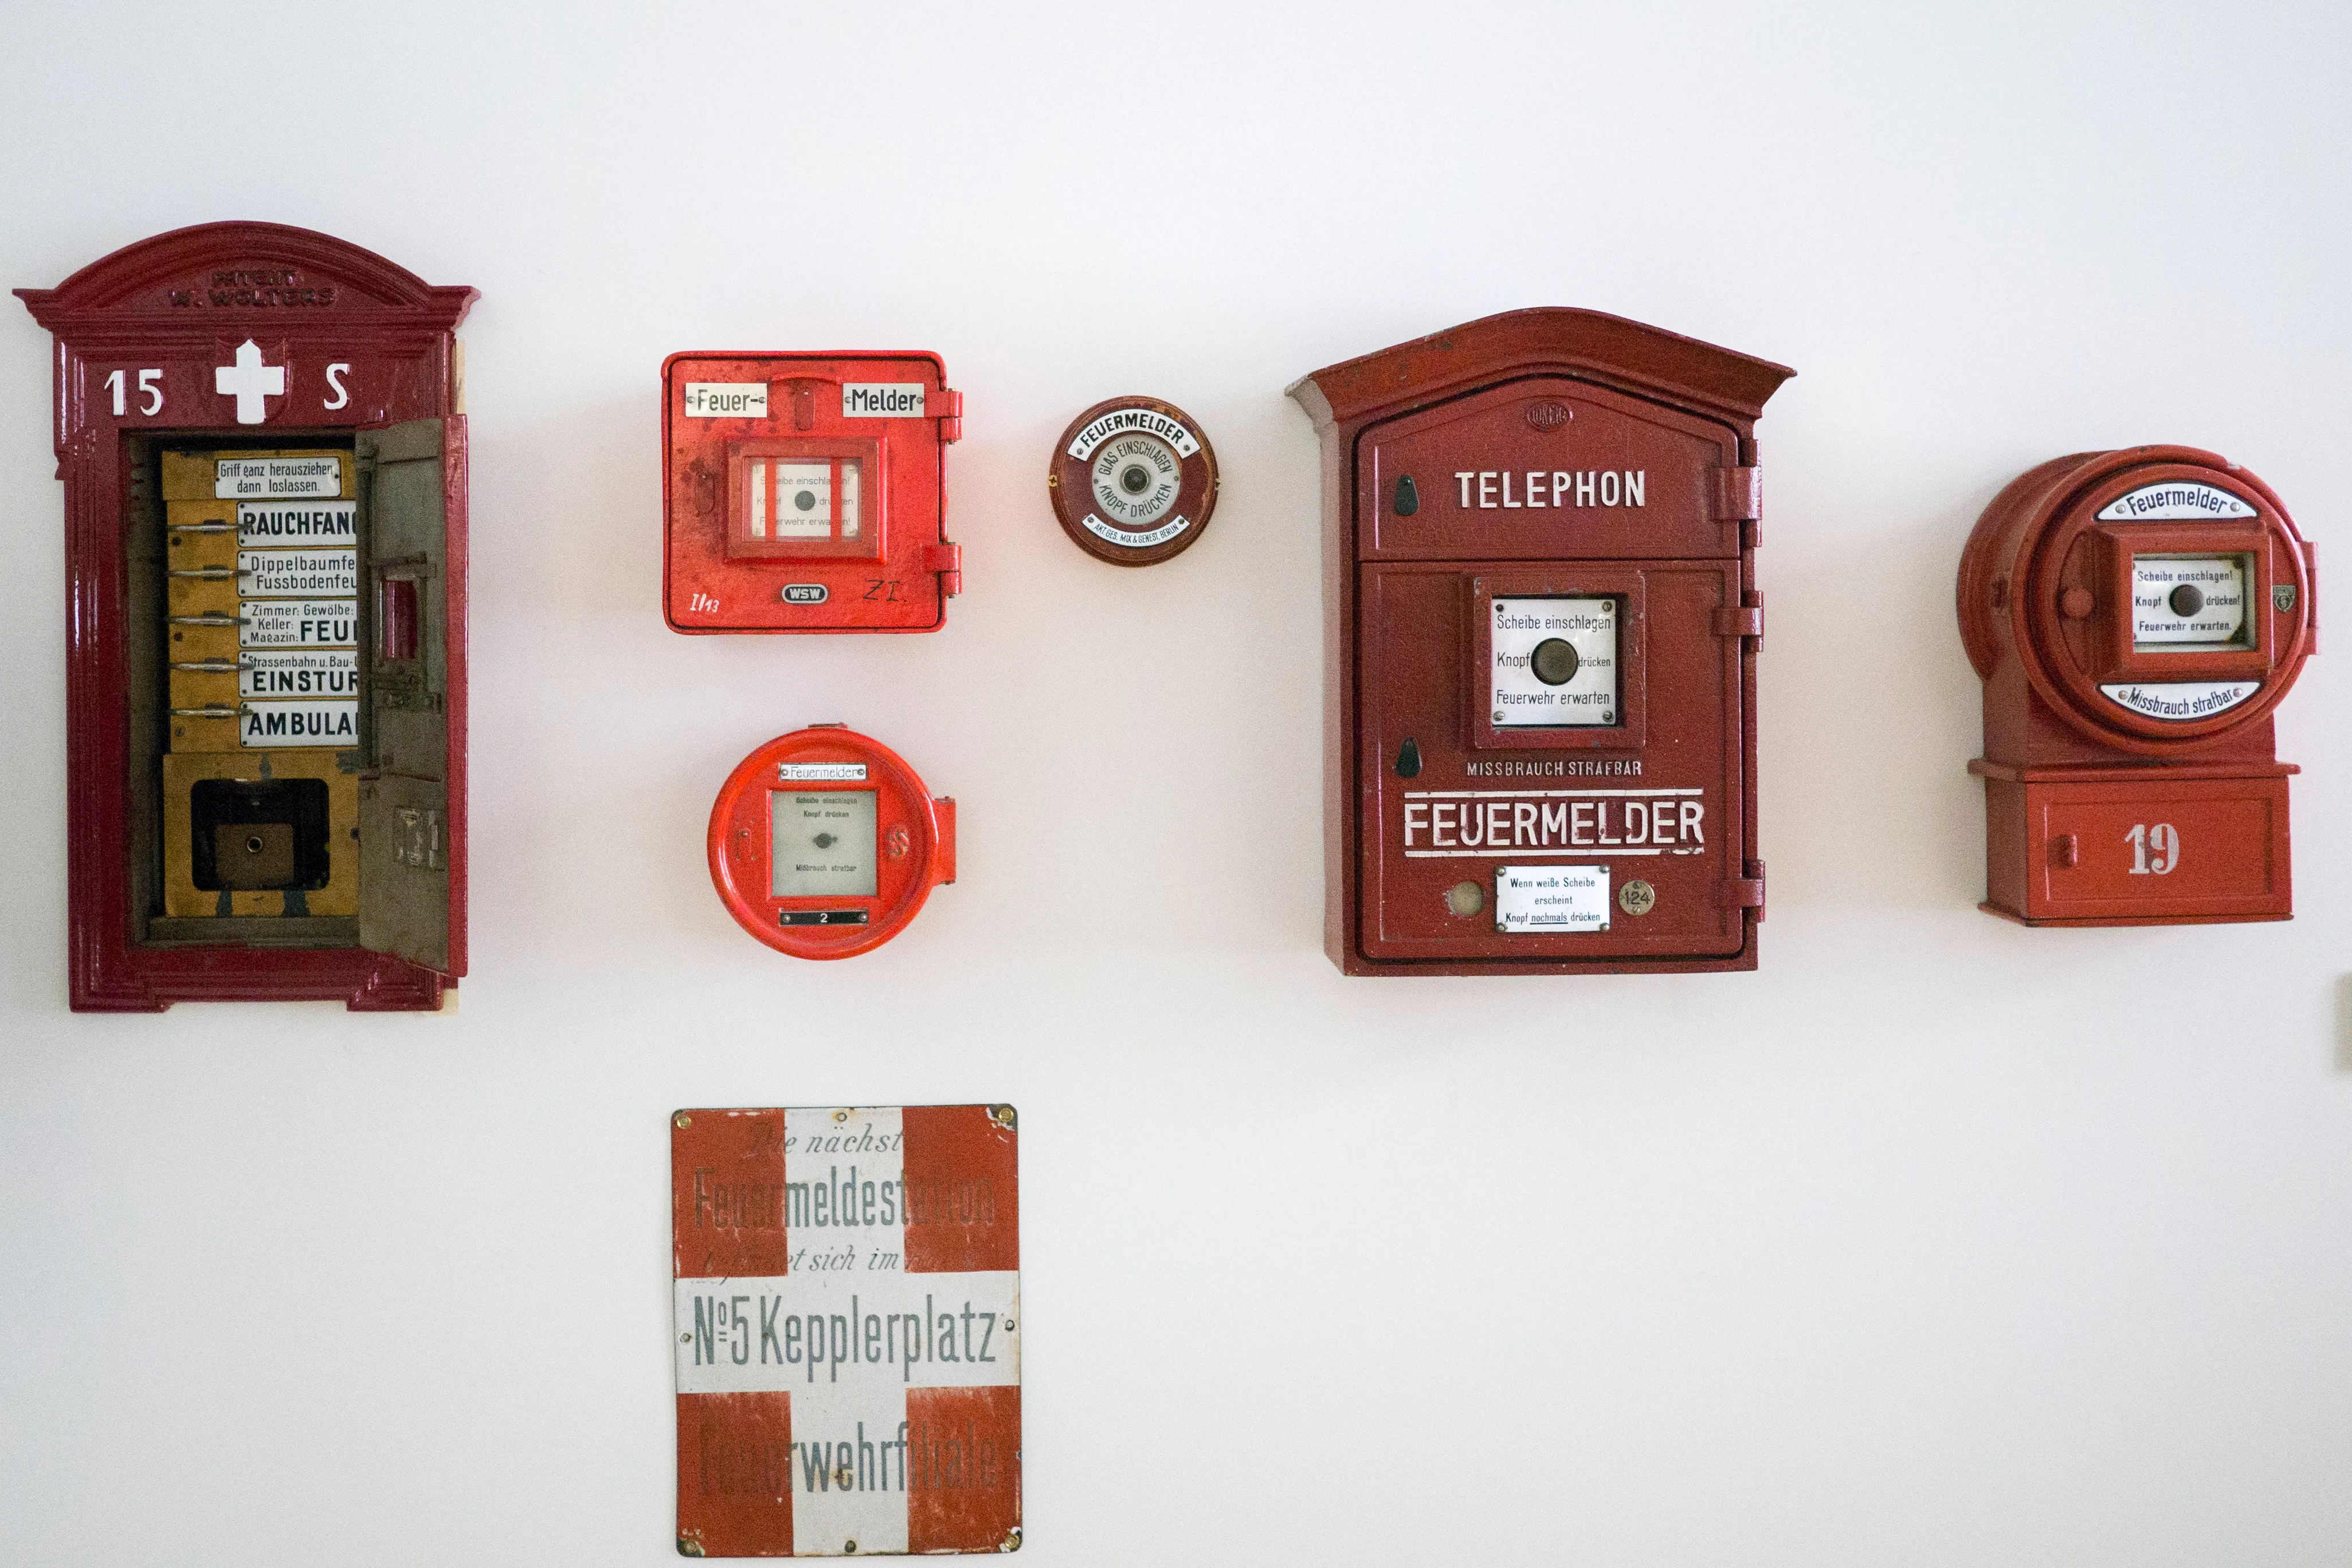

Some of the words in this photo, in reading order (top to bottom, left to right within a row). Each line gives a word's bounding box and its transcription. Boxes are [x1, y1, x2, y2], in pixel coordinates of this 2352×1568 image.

[104, 369, 163, 416] 15
[324, 363, 350, 410] S
[851, 389, 916, 411] Melder
[1080, 413, 1184, 448] FEUERMELDER
[1098, 450, 1119, 476] GLAS
[1116, 440, 1173, 474] EINSCHLAGEN
[221, 463, 241, 477] Griff
[243, 465, 265, 479] ganz
[269, 461, 333, 476] herausziehen
[237, 479, 261, 493] dann
[269, 479, 320, 492] loslassen.
[760, 476, 794, 485] Seibe
[796, 476, 850, 486] einschlan!
[1455, 470, 1645, 508] TELEPHON
[1099, 484, 1128, 515] KNOPF
[1131, 484, 1172, 518] DRÜCKEN
[2126, 487, 2228, 516] Feuermelder
[759, 516, 805, 526] Ferwehr
[1120, 534, 1131, 543] MIX
[1132, 535, 1137, 543] &
[1160, 523, 1179, 538] BERLIN
[2138, 571, 2173, 581] Scheibe
[2177, 571, 2233, 583] einschlagen!
[789, 588, 821, 599] WSW
[2135, 596, 2162, 609] Knopf
[2206, 595, 2240, 606] drücken!
[258, 618, 293, 630] Keller:
[1497, 614, 1540, 629] Scheibe
[1545, 614, 1610, 632] einschlagen
[2139, 621, 2186, 631] Feuerwehr
[2190, 621, 2232, 631] erwarten.
[250, 632, 299, 643] Magazin:
[248, 656, 316, 668] Strassenbahn
[1497, 652, 1531, 669] Knopf
[1578, 657, 1611, 667] drücken
[1496, 689, 1555, 705] Feuerwehr
[1561, 691, 1610, 705] erwarten
[2127, 687, 2189, 715] Missbrauch
[2192, 689, 2234, 714] strafbar
[791, 766, 859, 778] Feuermelder
[1467, 761, 1563, 776] MISSBRAUCH
[1569, 760, 1642, 776] STRAFBAR
[803, 810, 821, 818] Knopf
[1405, 800, 1704, 847] FEUERMELDER
[2124, 822, 2179, 875] 19
[1510, 878, 1533, 888] Wenn
[1536, 877, 1559, 888] weiße
[1563, 877, 1596, 887] Scheibe
[1535, 894, 1573, 905] erscheint
[1624, 890, 1651, 905] 124
[820, 913, 828, 923] 2
[1506, 912, 1528, 924] Knopf
[1531, 912, 1567, 922] nochmals
[1570, 911, 1601, 922] drücken
[809, 1245, 856, 1271] sich
[867, 1248, 899, 1271] im
[760, 1293, 997, 1383] Kepplerplatz
